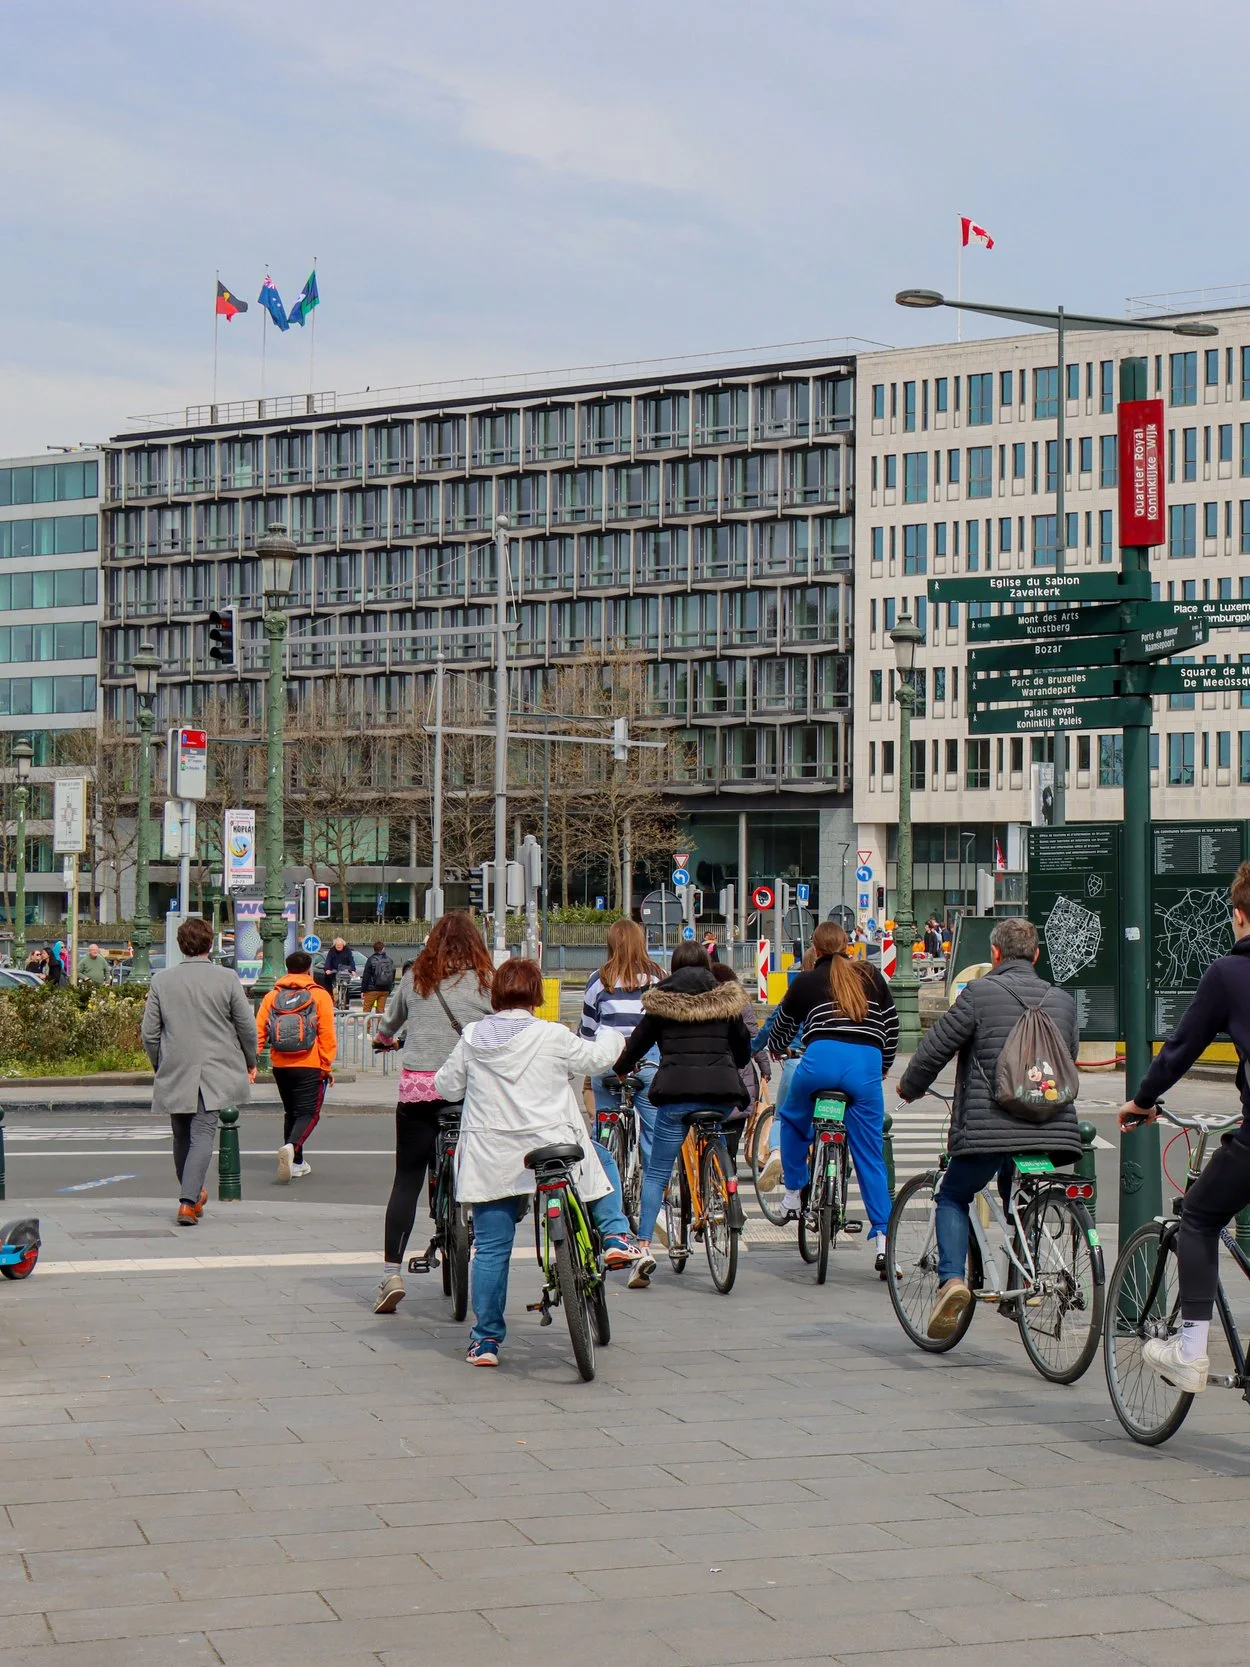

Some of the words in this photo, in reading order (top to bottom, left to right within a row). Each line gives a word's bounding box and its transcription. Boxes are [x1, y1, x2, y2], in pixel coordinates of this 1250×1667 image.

[1146, 424, 1158, 450] Wijk
[1134, 428, 1145, 460] Royal
[1135, 466, 1145, 516] Quartier
[1148, 456, 1158, 520] Koninklijke
[990, 577, 1021, 588] Eglise
[1026, 577, 1040, 586] du
[1045, 576, 1080, 586] Sablon
[1010, 587, 1060, 597] Zavelkerk
[1174, 604, 1198, 614] Place
[1203, 603, 1215, 612] du
[1018, 615, 1038, 625] Mont
[1042, 613, 1057, 622] des
[1062, 612, 1079, 621] Arts
[1027, 623, 1070, 634] Kunstberg
[1141, 632, 1154, 642] Porte
[1156, 630, 1162, 639] de
[1034, 644, 1062, 655] Bozar
[1180, 666, 1216, 677] Square
[1223, 666, 1236, 675] de
[1012, 678, 1030, 687] Parc
[1034, 676, 1044, 685] de
[1048, 673, 1086, 684] Bruxelles
[1184, 678, 1197, 688] De
[1021, 685, 1076, 697] Warandepark
[1024, 708, 1048, 717] Palais
[1052, 706, 1075, 717] Royal
[1016, 718, 1055, 728] Koninklijk
[1059, 716, 1082, 725] Paleis
